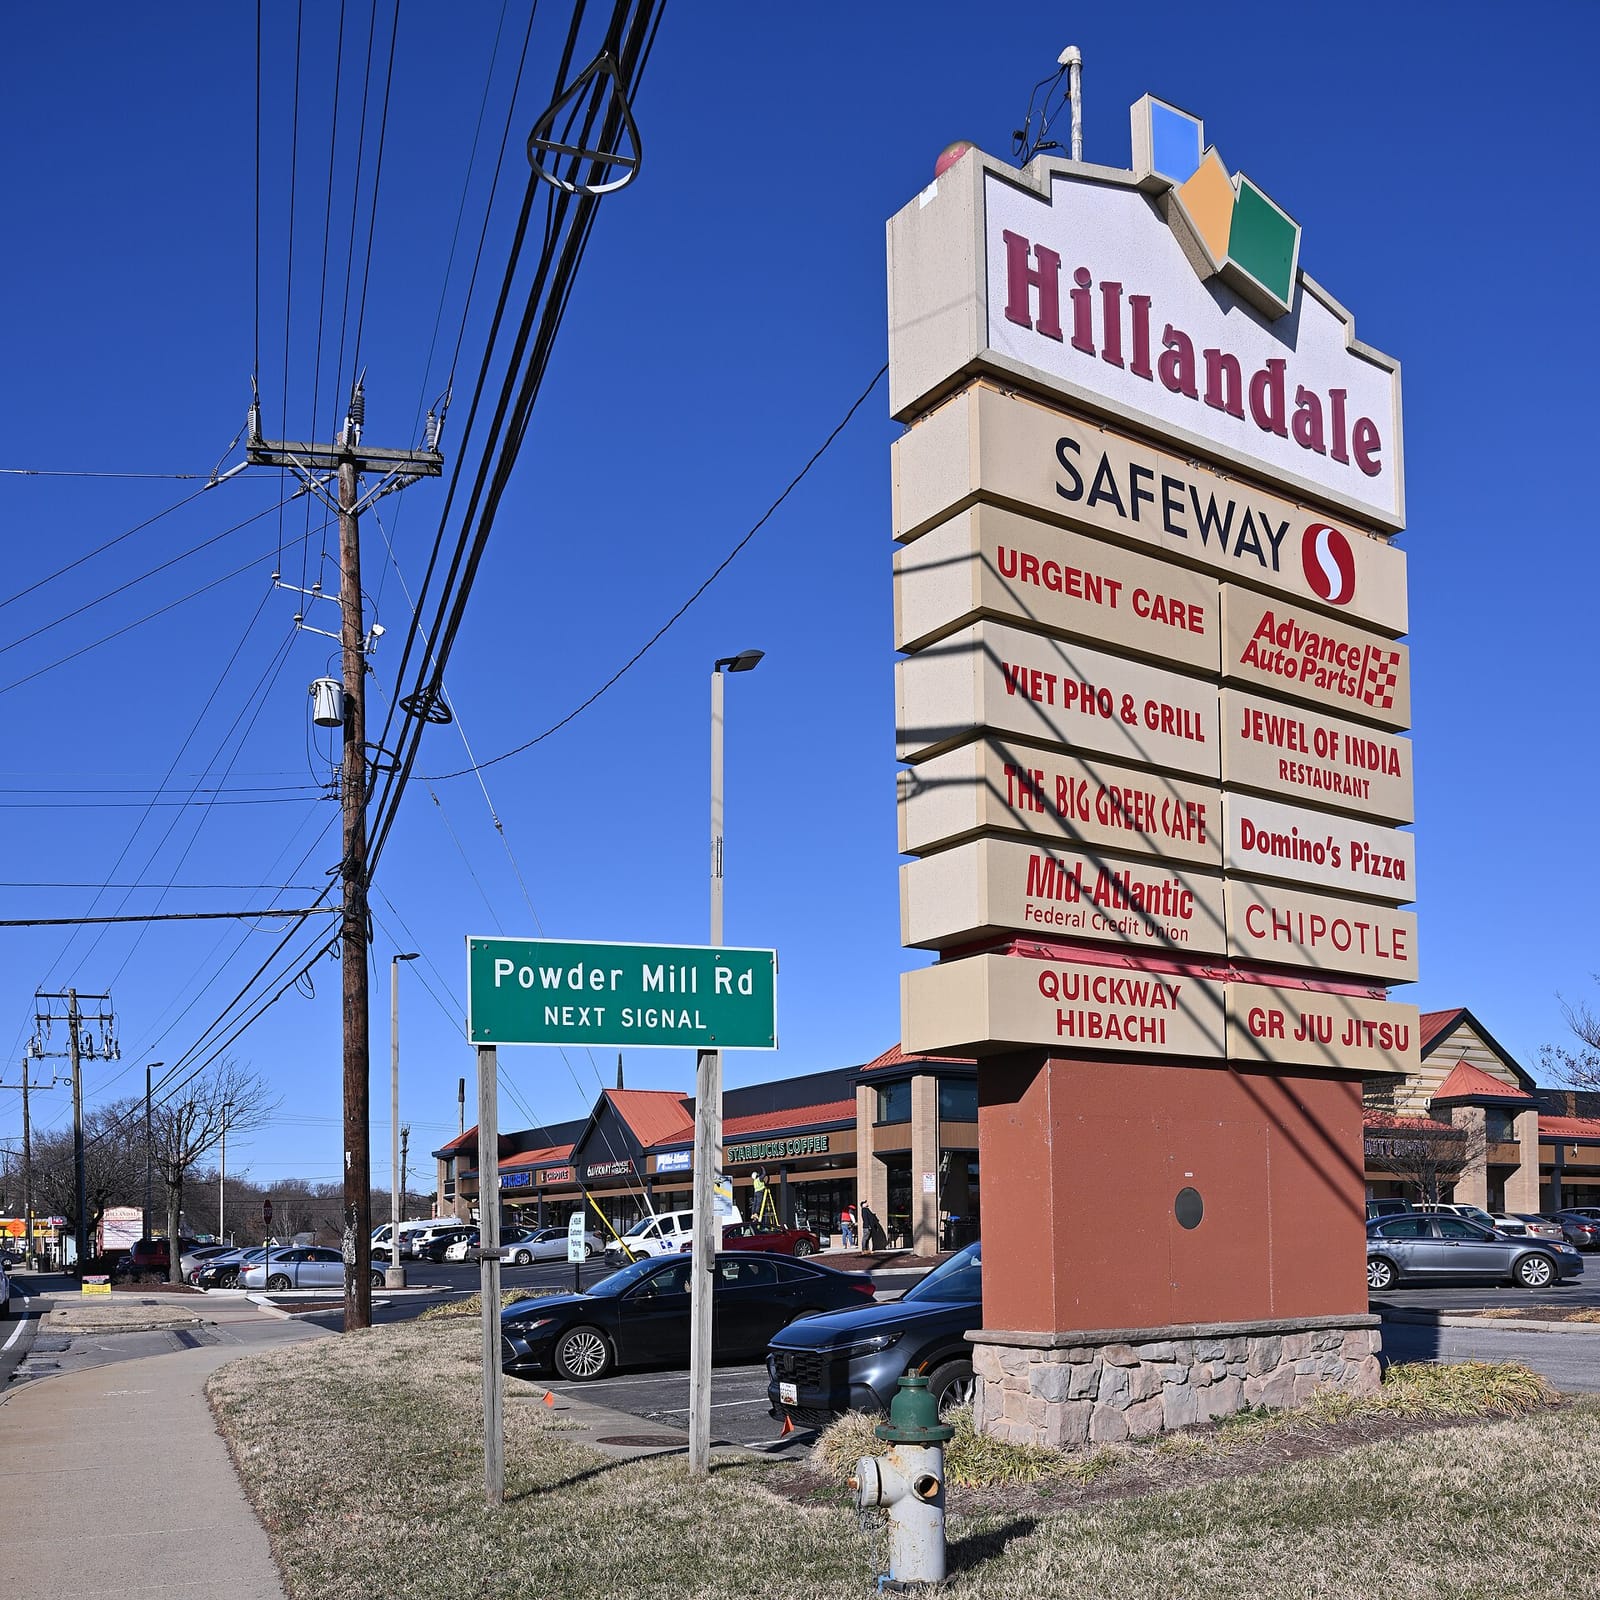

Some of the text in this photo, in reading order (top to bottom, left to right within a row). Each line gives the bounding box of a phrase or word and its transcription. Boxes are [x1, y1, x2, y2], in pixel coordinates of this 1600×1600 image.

[1003, 229, 1382, 477] Hillandale
[1055, 437, 1290, 572] SAFEWAY
[997, 546, 1205, 635] URGENT CARE
[1253, 610, 1361, 670] Advance
[1240, 640, 1357, 699] Auto Parts
[1002, 662, 1205, 743] VIET PHO & GRILL
[1241, 707, 1401, 778] JEWEL OF INDIA
[1003, 763, 1206, 844] THE BIG GREEK CAFE
[1279, 759, 1370, 800] RESTAURANT
[1240, 817, 1406, 881] Domino's Pizza
[1026, 854, 1194, 920] Mid-Atlantic
[1025, 903, 1189, 942] Federal Credit Union
[1245, 904, 1408, 961] CHIPOTLE
[494, 958, 753, 996] Powder Mill Rd
[1038, 970, 1182, 1011] QUICKWAY
[544, 1006, 707, 1030] NEXT SIGNAL
[1056, 1008, 1166, 1045] HIBACHI
[1248, 1007, 1410, 1052] GR JIU JITSU
[546, 1169, 569, 1181] CHIPOTLE
[727, 1135, 829, 1162] STARBUCKS COFFEE
